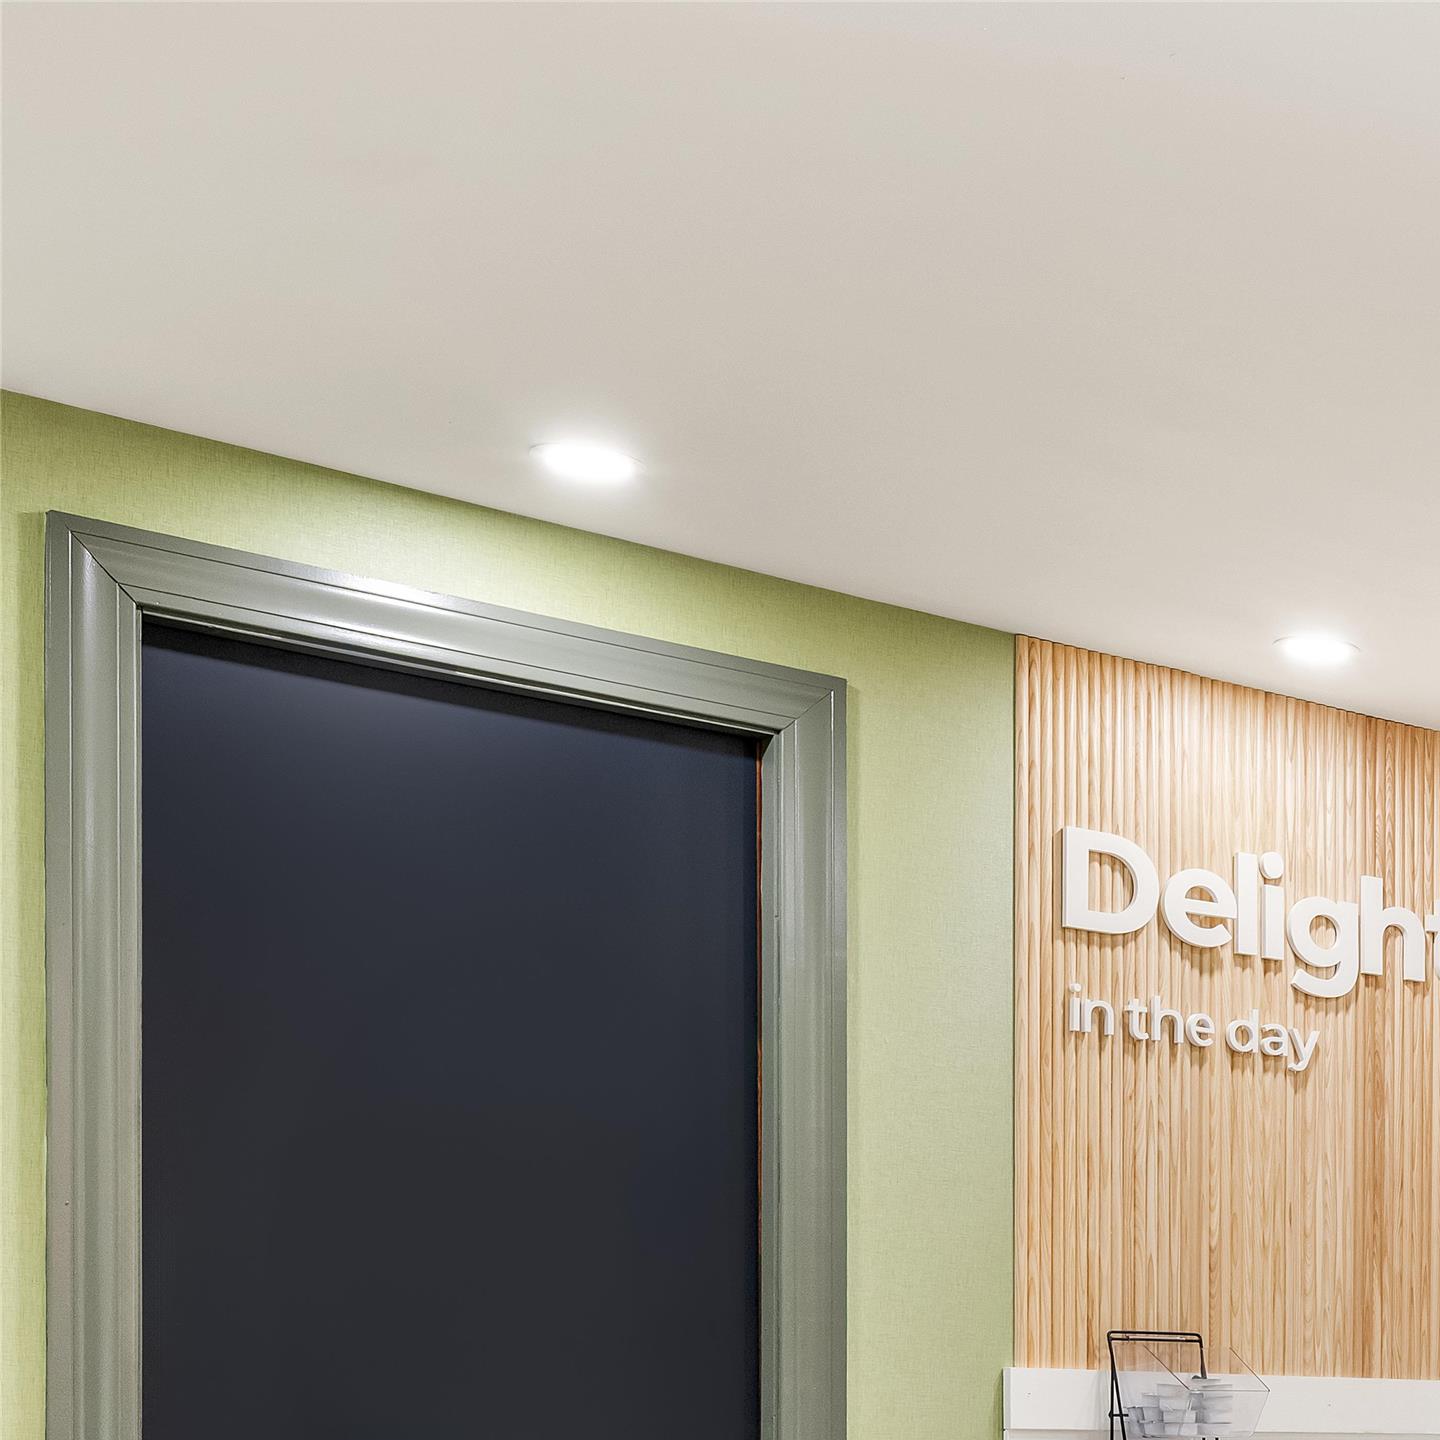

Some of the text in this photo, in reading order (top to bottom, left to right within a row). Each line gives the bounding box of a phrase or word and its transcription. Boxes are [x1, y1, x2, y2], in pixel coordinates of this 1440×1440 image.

[1069, 983, 1320, 1072] in the day
